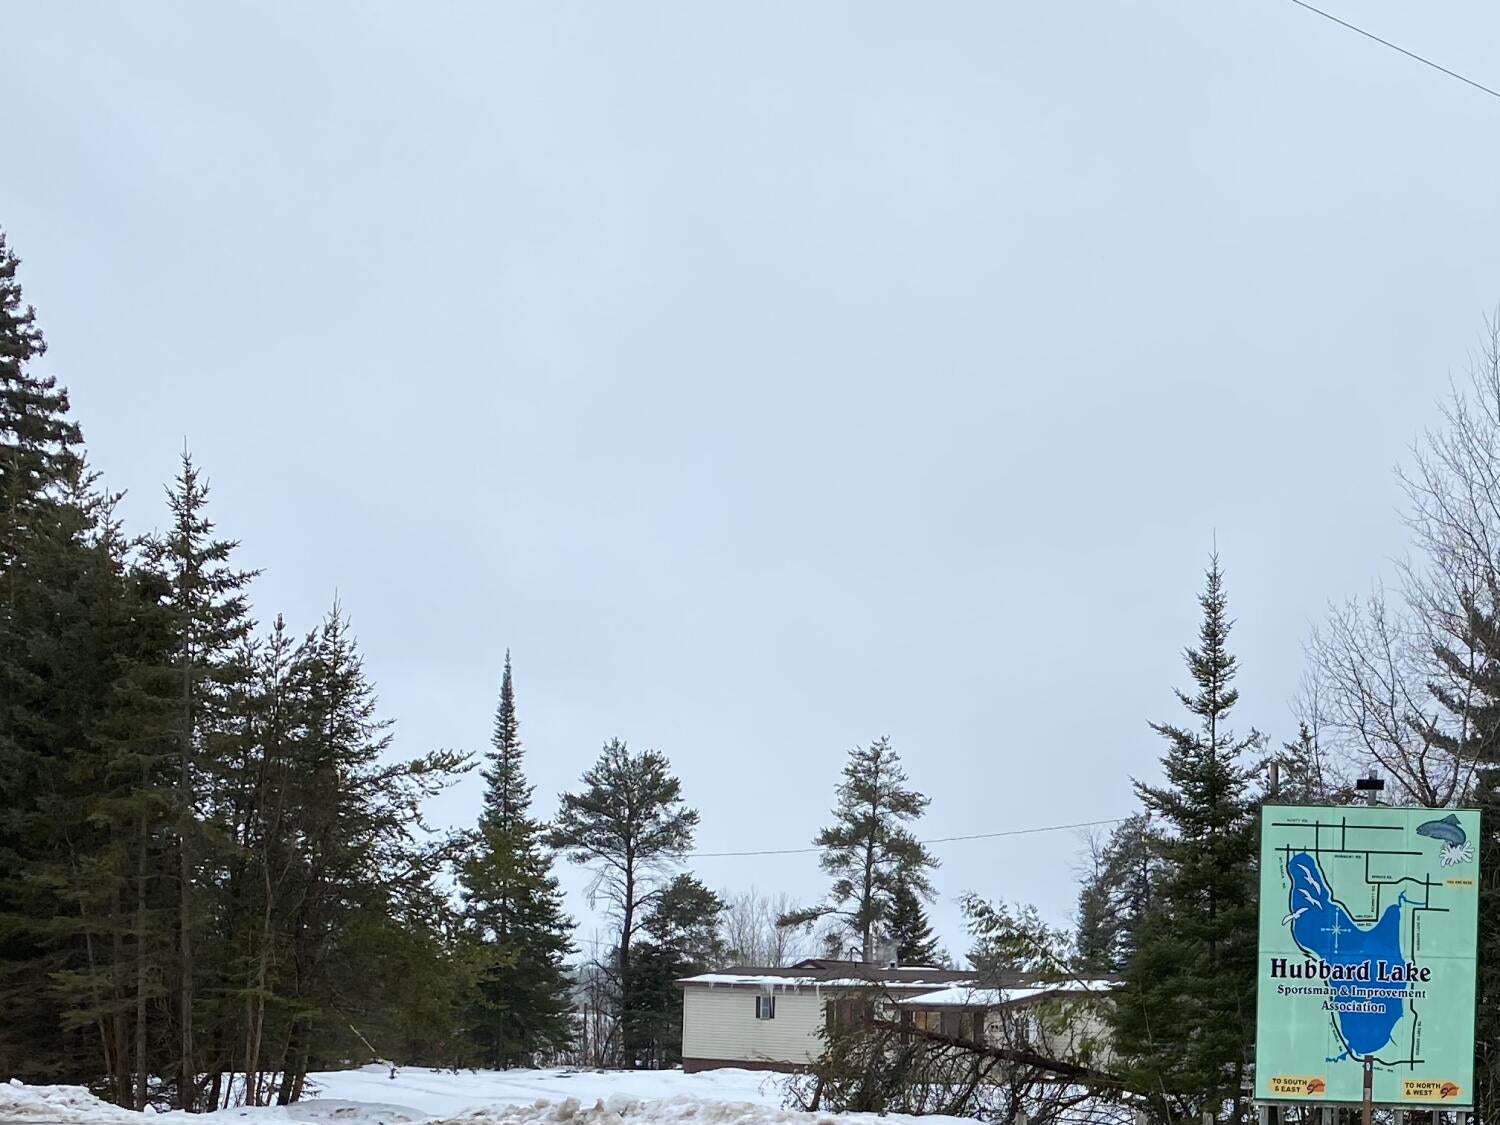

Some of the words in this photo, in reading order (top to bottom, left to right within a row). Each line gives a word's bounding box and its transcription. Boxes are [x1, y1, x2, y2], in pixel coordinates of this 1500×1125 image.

[1270, 958, 1370, 981] Hubbard
[1377, 961, 1431, 982] Lake
[1277, 985, 1337, 996] Sportsman
[1339, 986, 1349, 996] &
[1351, 987, 1426, 998] Improvement
[1321, 1000, 1385, 1012] Association
